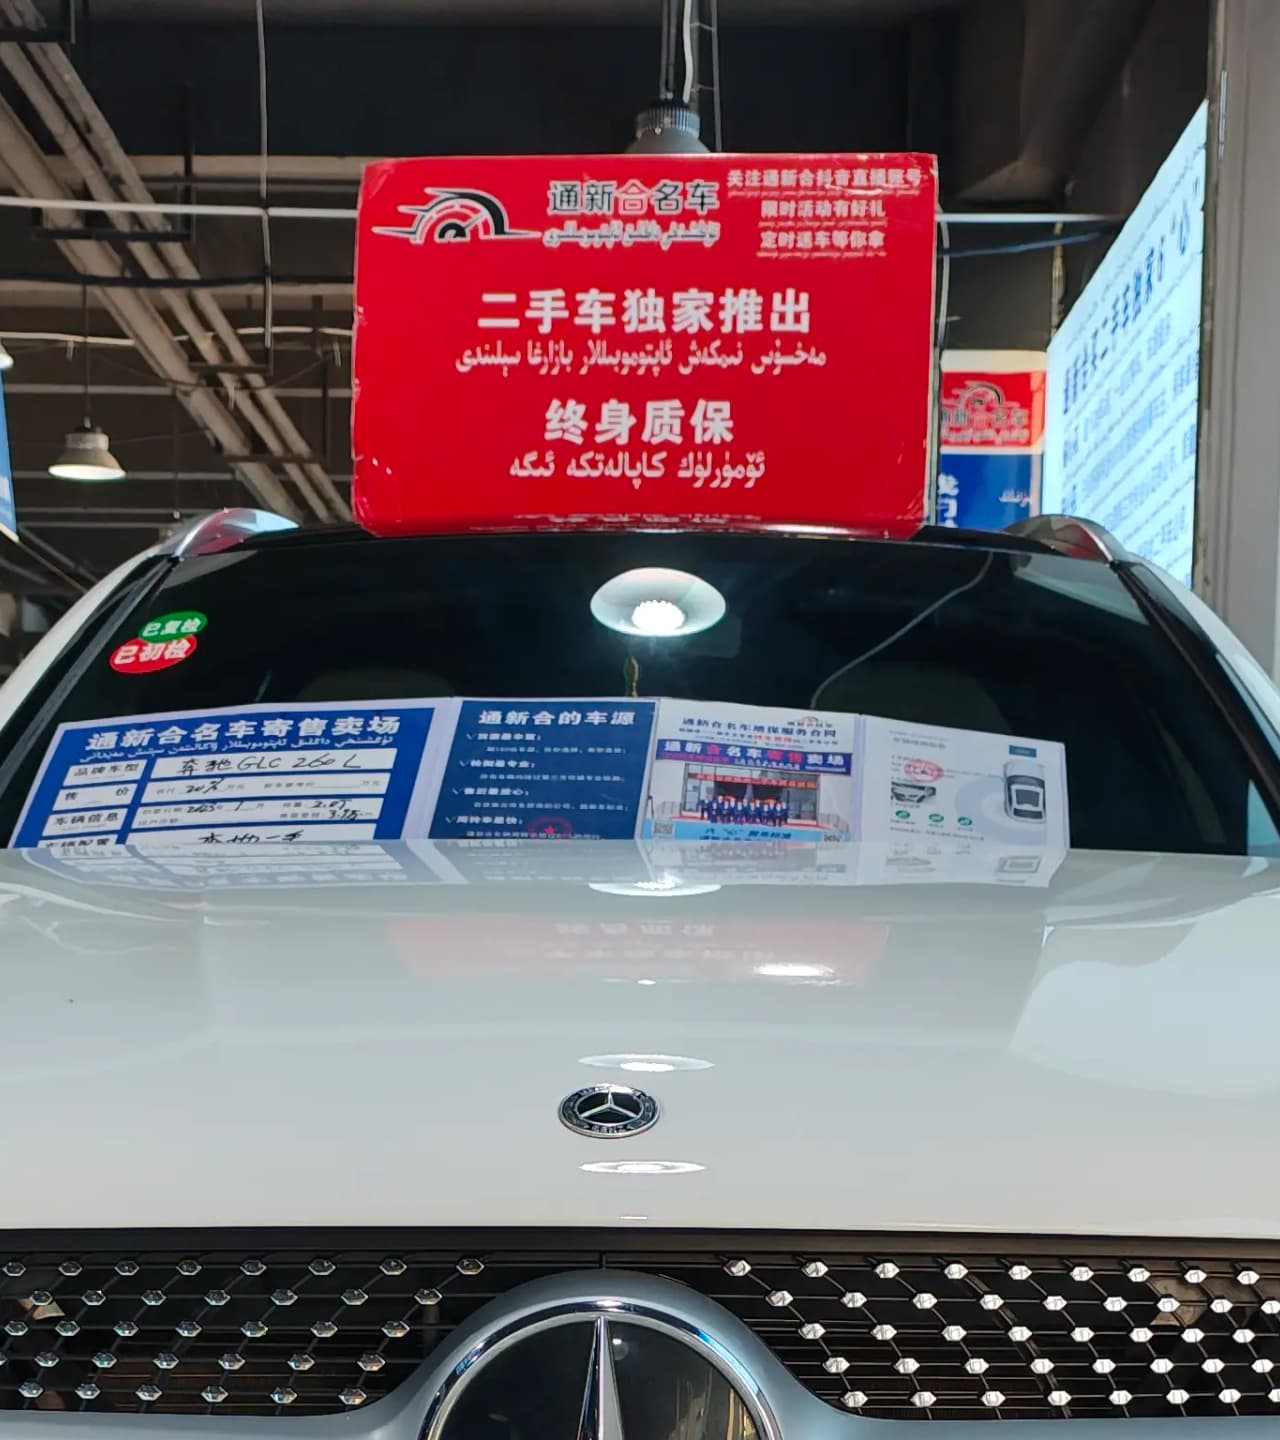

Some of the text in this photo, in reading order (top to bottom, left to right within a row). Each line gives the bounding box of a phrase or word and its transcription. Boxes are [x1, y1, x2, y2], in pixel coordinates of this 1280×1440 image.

[547, 179, 720, 215] 通新合名车
[477, 287, 811, 335] 二手车独家推出
[544, 398, 735, 445] 终身质保
[85, 715, 401, 751] 通新合名车寄售卖场
[478, 709, 636, 726] 通新合的车源
